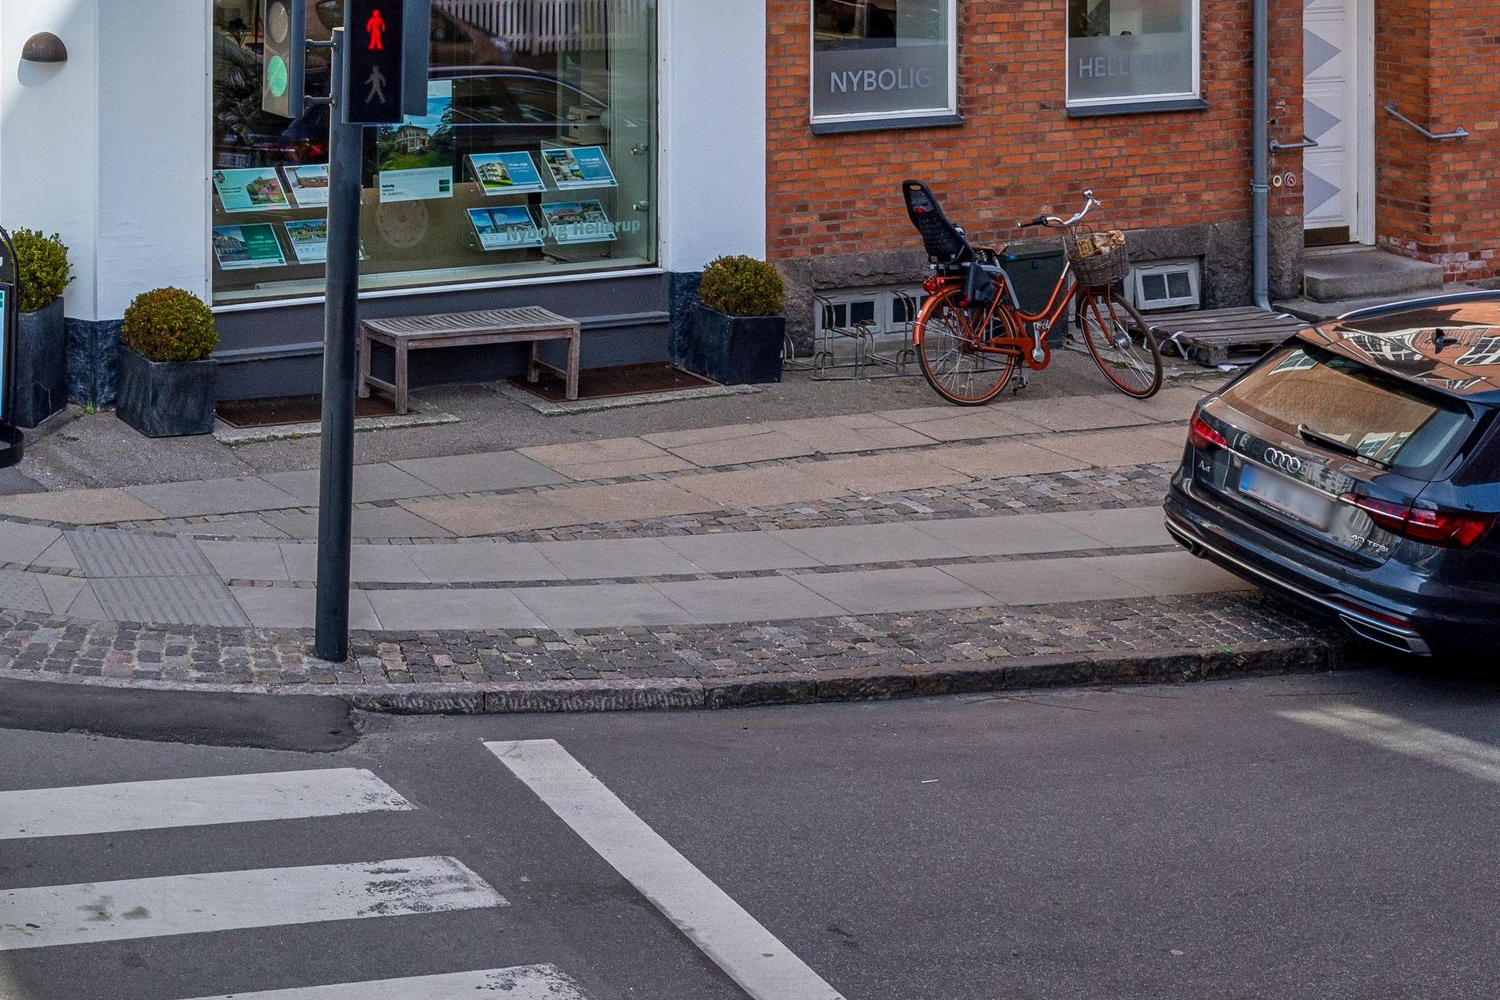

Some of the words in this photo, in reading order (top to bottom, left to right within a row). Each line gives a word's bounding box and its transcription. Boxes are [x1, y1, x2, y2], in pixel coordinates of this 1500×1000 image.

[830, 67, 932, 94] NYBOLIG
[507, 224, 567, 242] Nybolig
[573, 218, 640, 235] Hellerup
[1197, 460, 1211, 473] A4
